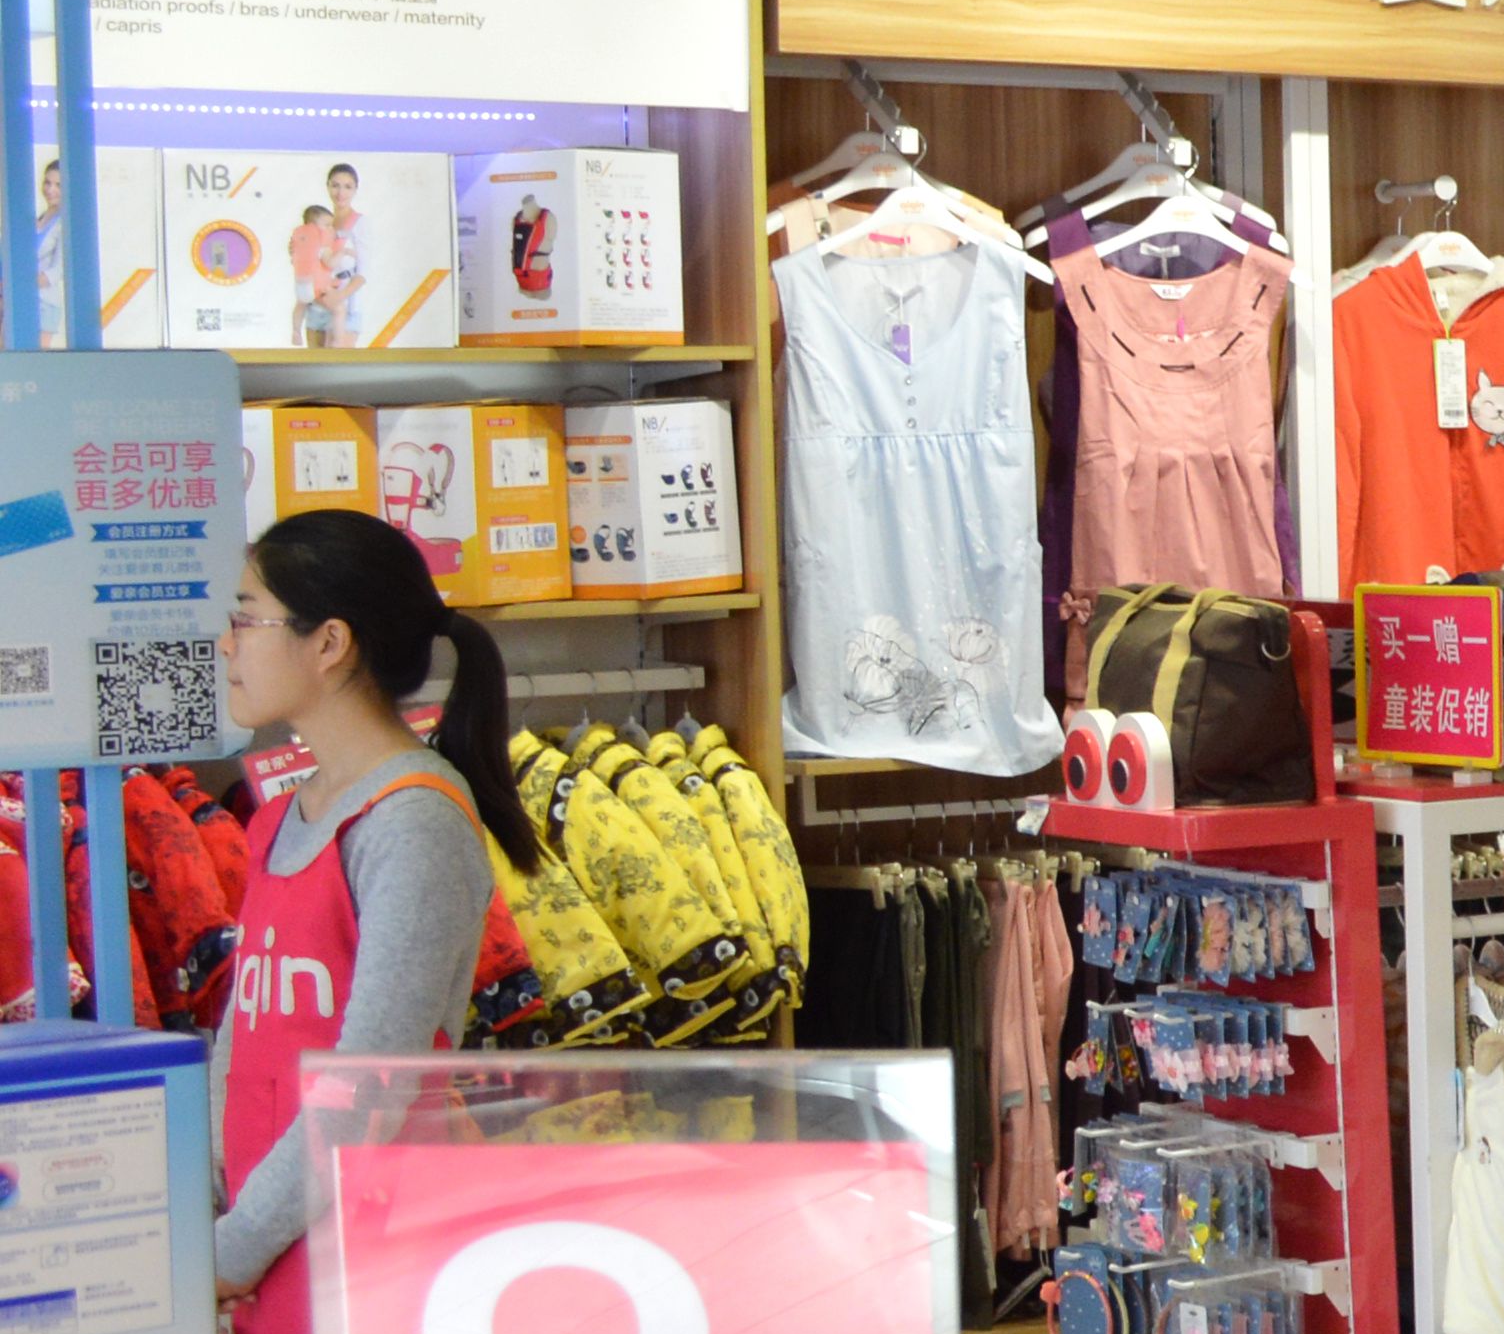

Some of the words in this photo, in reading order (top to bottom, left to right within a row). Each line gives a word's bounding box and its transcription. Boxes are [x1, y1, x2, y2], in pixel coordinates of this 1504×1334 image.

[105, 17, 163, 36] capris
[239, 0, 279, 18] bras
[294, 5, 390, 23] underwear
[403, 9, 486, 31] maternity
[72, 440, 217, 475] 会员可享
[74, 476, 218, 512] 更多优惠
[1378, 614, 1489, 668] 买一赠一
[1379, 681, 1490, 740] 童装促销
